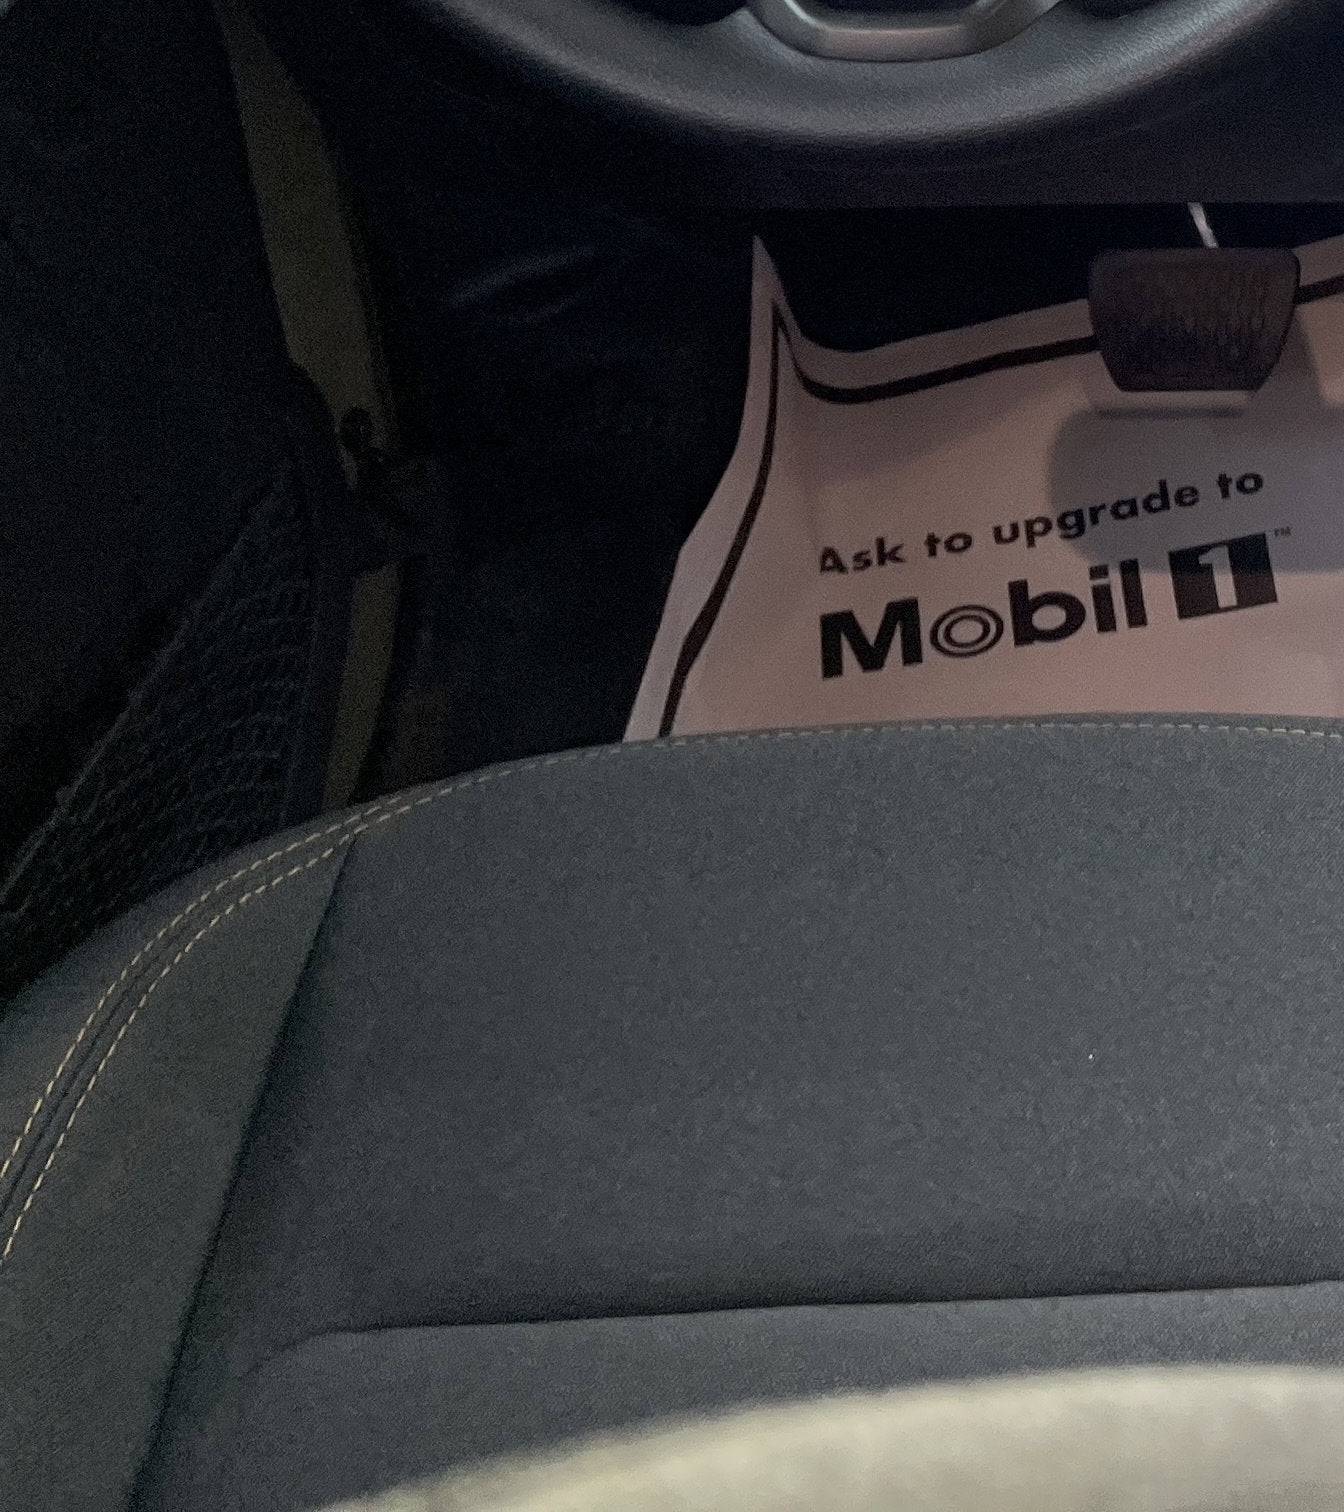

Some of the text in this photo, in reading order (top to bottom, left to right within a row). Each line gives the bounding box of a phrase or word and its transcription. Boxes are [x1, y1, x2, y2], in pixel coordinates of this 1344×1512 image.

[817, 467, 1265, 577] Ask to upgrade to
[817, 556, 1150, 680] Mobil
